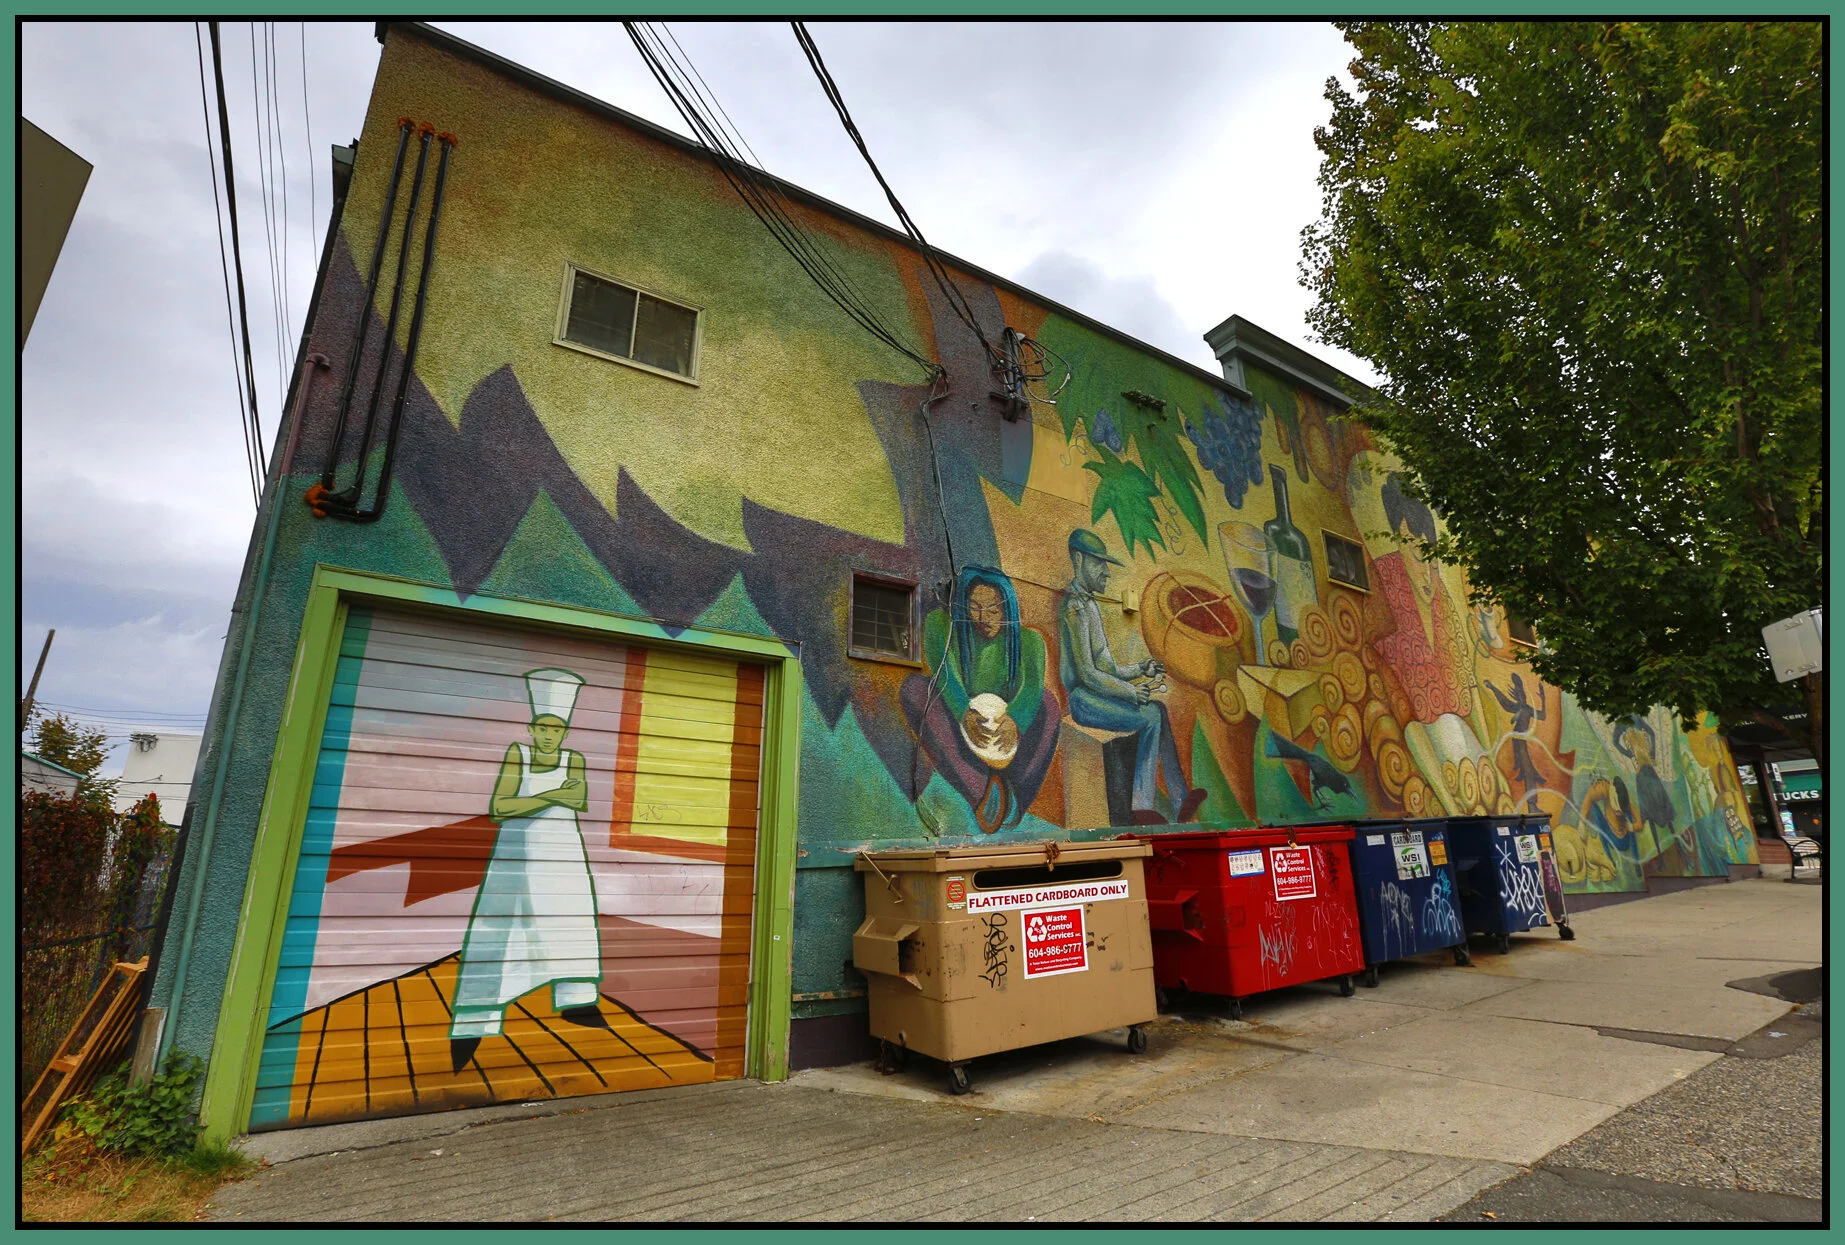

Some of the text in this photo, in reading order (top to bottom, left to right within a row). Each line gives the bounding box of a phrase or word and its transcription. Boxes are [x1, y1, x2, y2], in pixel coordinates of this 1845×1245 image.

[1520, 841, 1533, 849] WSI
[1401, 853, 1421, 862] WSI
[969, 893, 1033, 908] FLATTENED
[1035, 887, 1098, 903] CARDBOARD
[1100, 884, 1127, 896] ONLY
[1047, 922, 1073, 931] Control
[1047, 931, 1074, 940] Services
[1028, 942, 1082, 958] 604-986-9777
